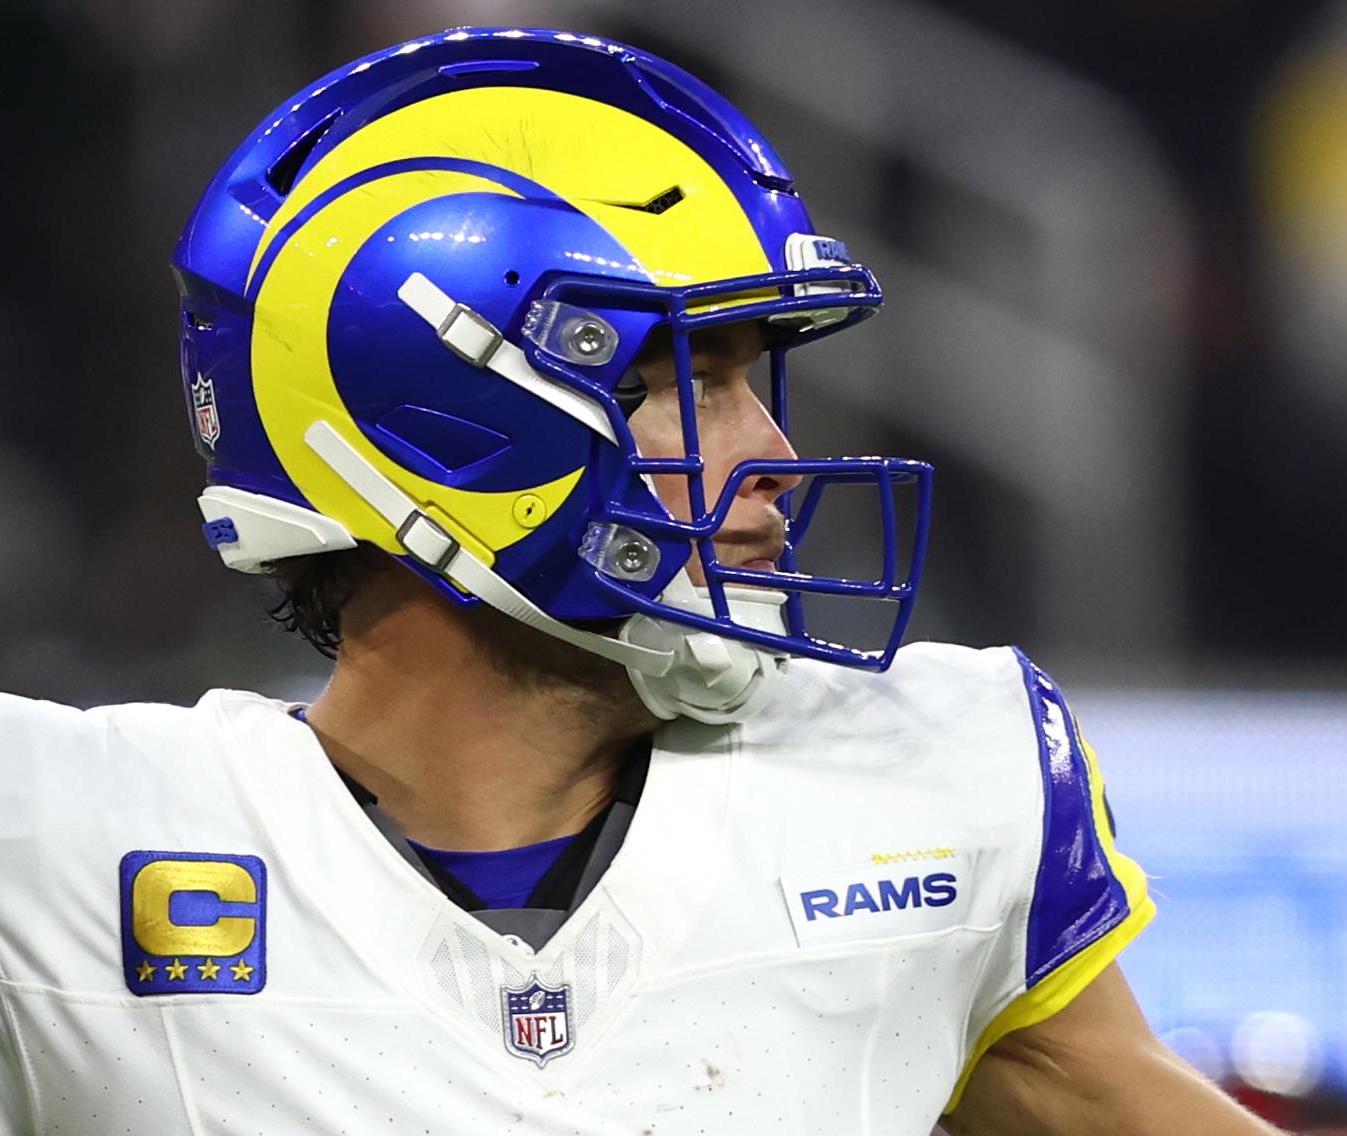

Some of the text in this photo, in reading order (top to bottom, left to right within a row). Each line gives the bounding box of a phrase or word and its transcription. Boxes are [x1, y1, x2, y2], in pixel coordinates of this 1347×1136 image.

[131, 859, 257, 957] C
[799, 871, 958, 922] RAMS
[514, 1015, 564, 1051] NFL
